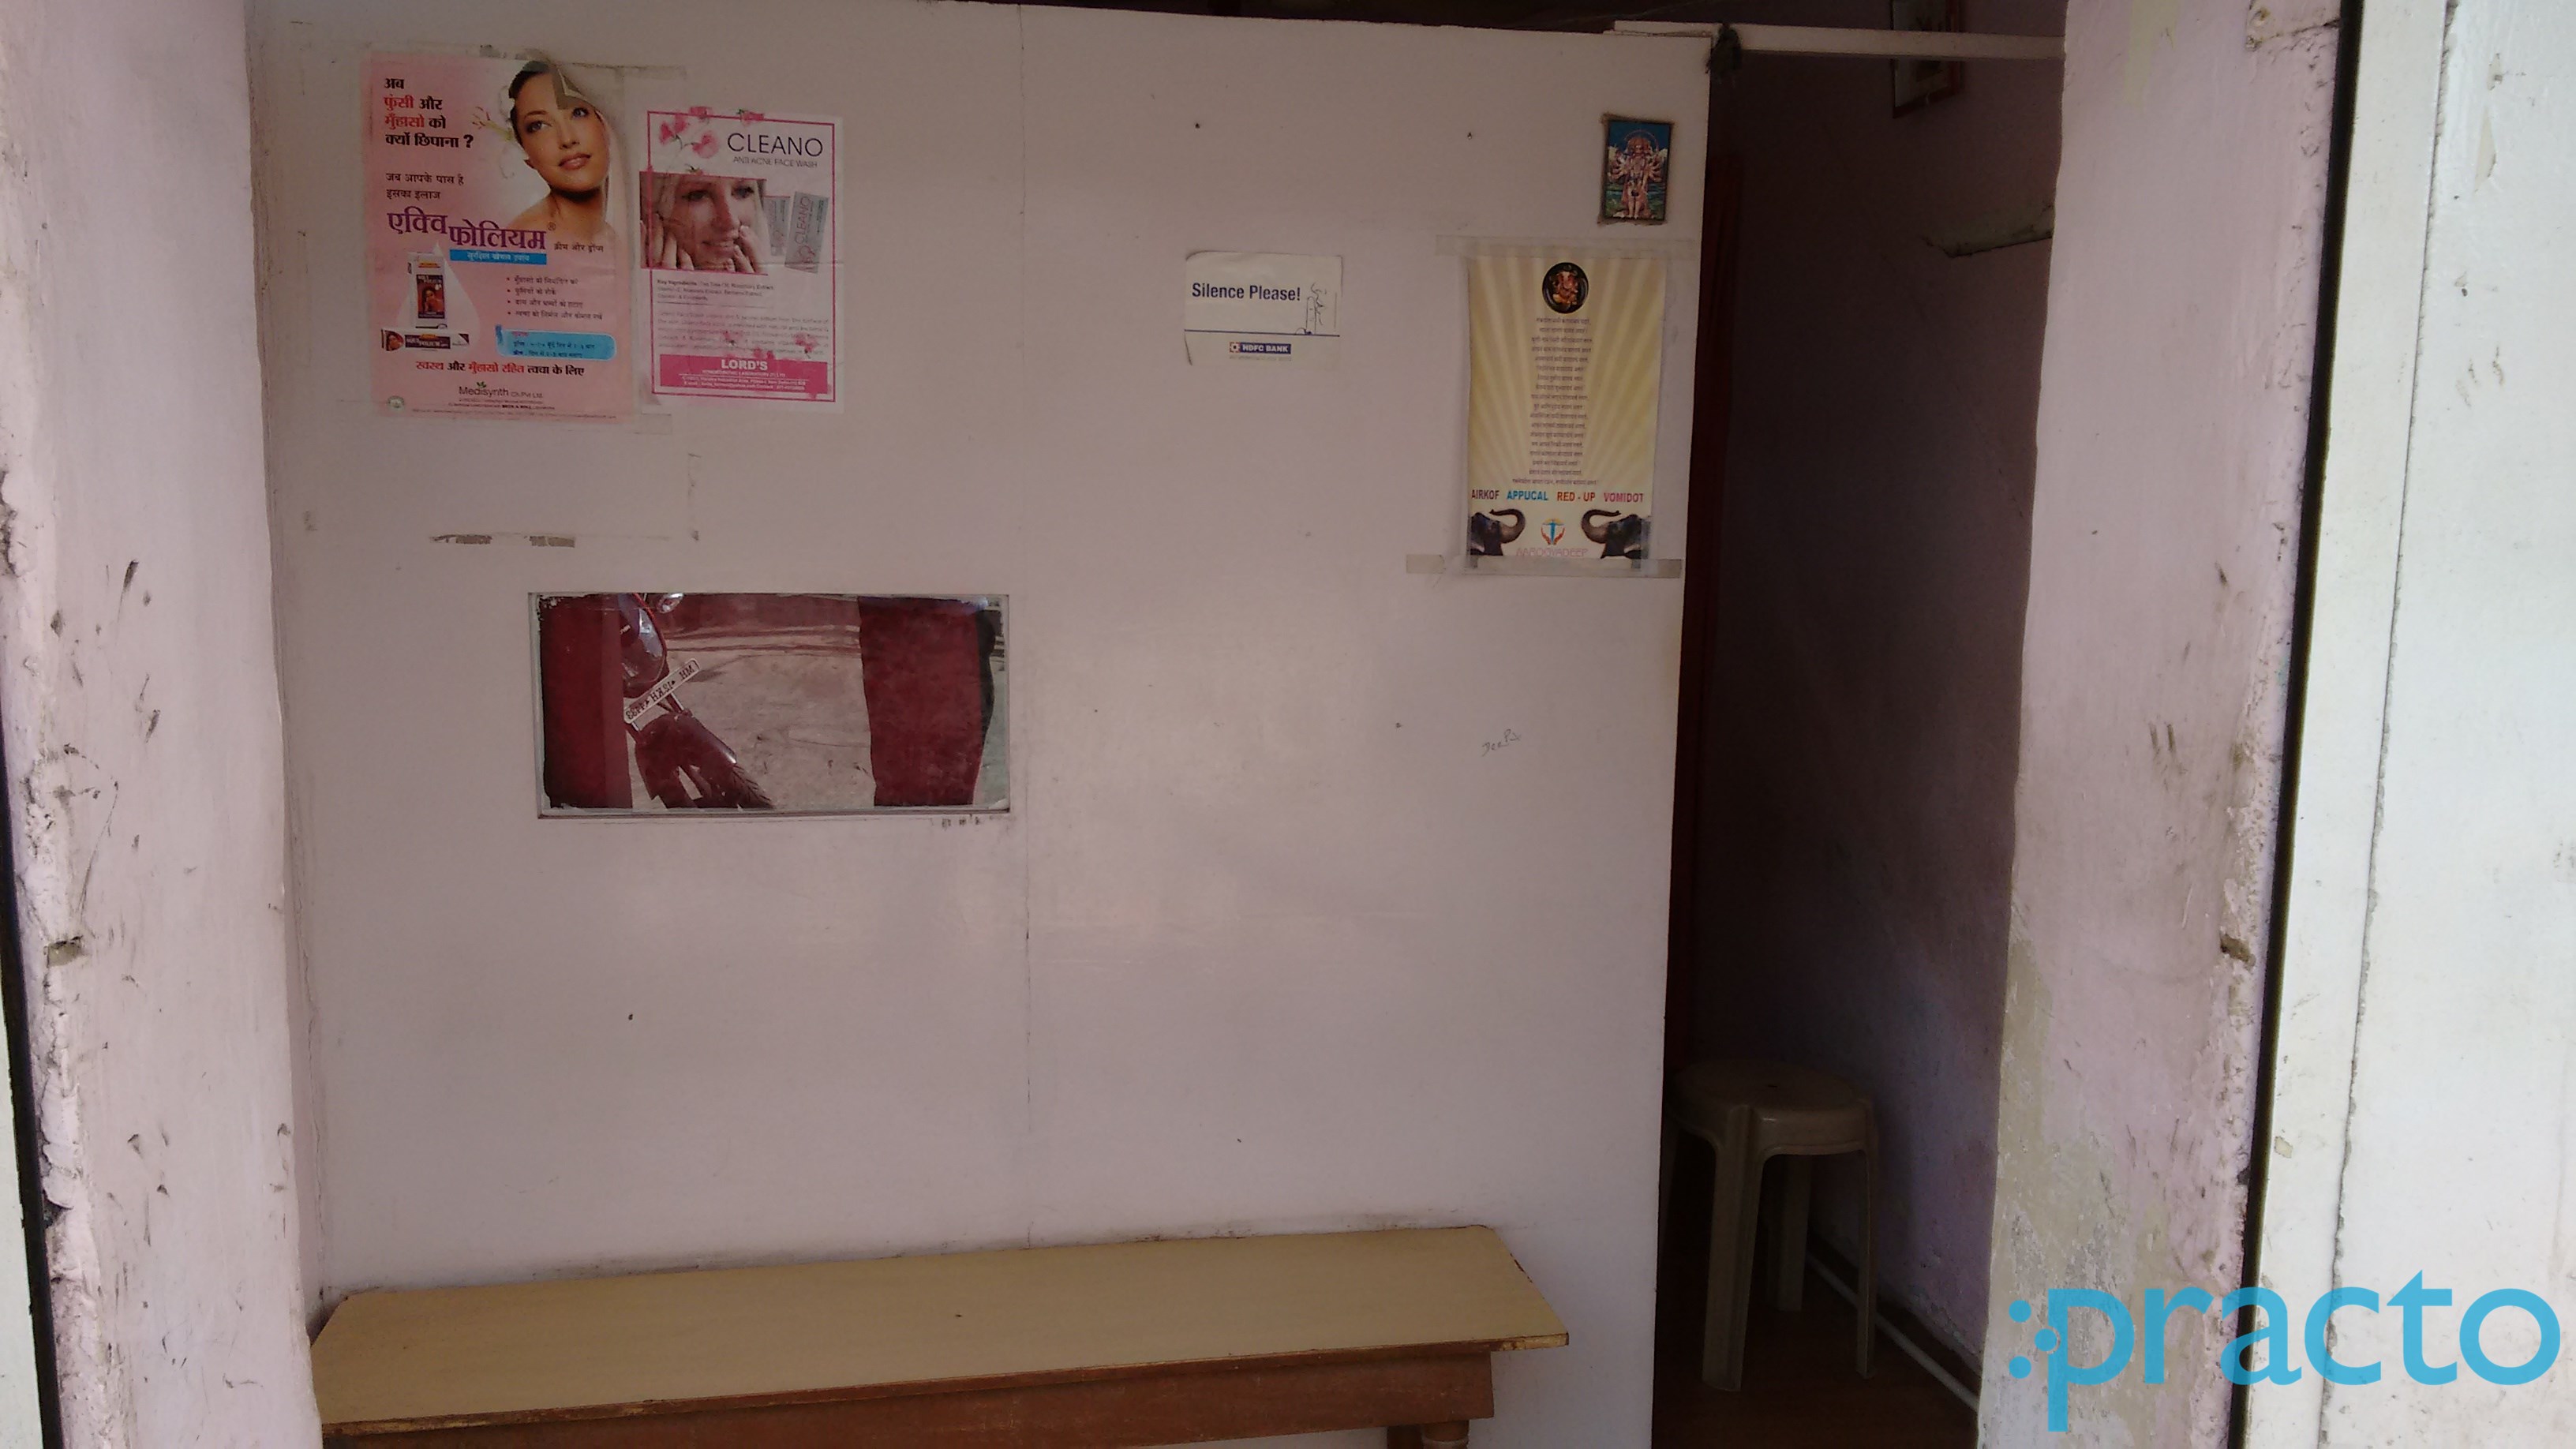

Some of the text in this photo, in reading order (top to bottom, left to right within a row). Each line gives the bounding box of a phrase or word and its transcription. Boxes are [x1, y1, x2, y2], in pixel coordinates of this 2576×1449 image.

[384, 78, 404, 89] अब
[384, 94, 442, 110] फुंसी और
[429, 114, 446, 129] को
[385, 132, 474, 148] क्यों छिपाना ?
[727, 132, 823, 157] CLEANO
[774, 159, 794, 167] FACE
[796, 160, 818, 169] WASH
[386, 173, 401, 182] जब
[405, 172, 432, 182] आपके
[436, 175, 455, 184] पास
[386, 189, 440, 200] इसका इलाज
[448, 219, 546, 250] फोलियम
[1192, 283, 1301, 301] Silence Please!
[447, 360, 466, 371] और
[502, 362, 524, 373] रहित
[527, 365, 549, 375] त्वचा
[552, 364, 563, 375] के
[565, 365, 584, 376] लिए
[721, 359, 768, 371] LORD'S
[459, 386, 509, 398] Medisynth
[1471, 489, 1500, 500] AIRKOF
[1507, 490, 1548, 501] APPUCAL
[1556, 492, 1575, 502] RED
[1583, 492, 1596, 502] UP
[1604, 492, 1644, 503] VOMIDOT
